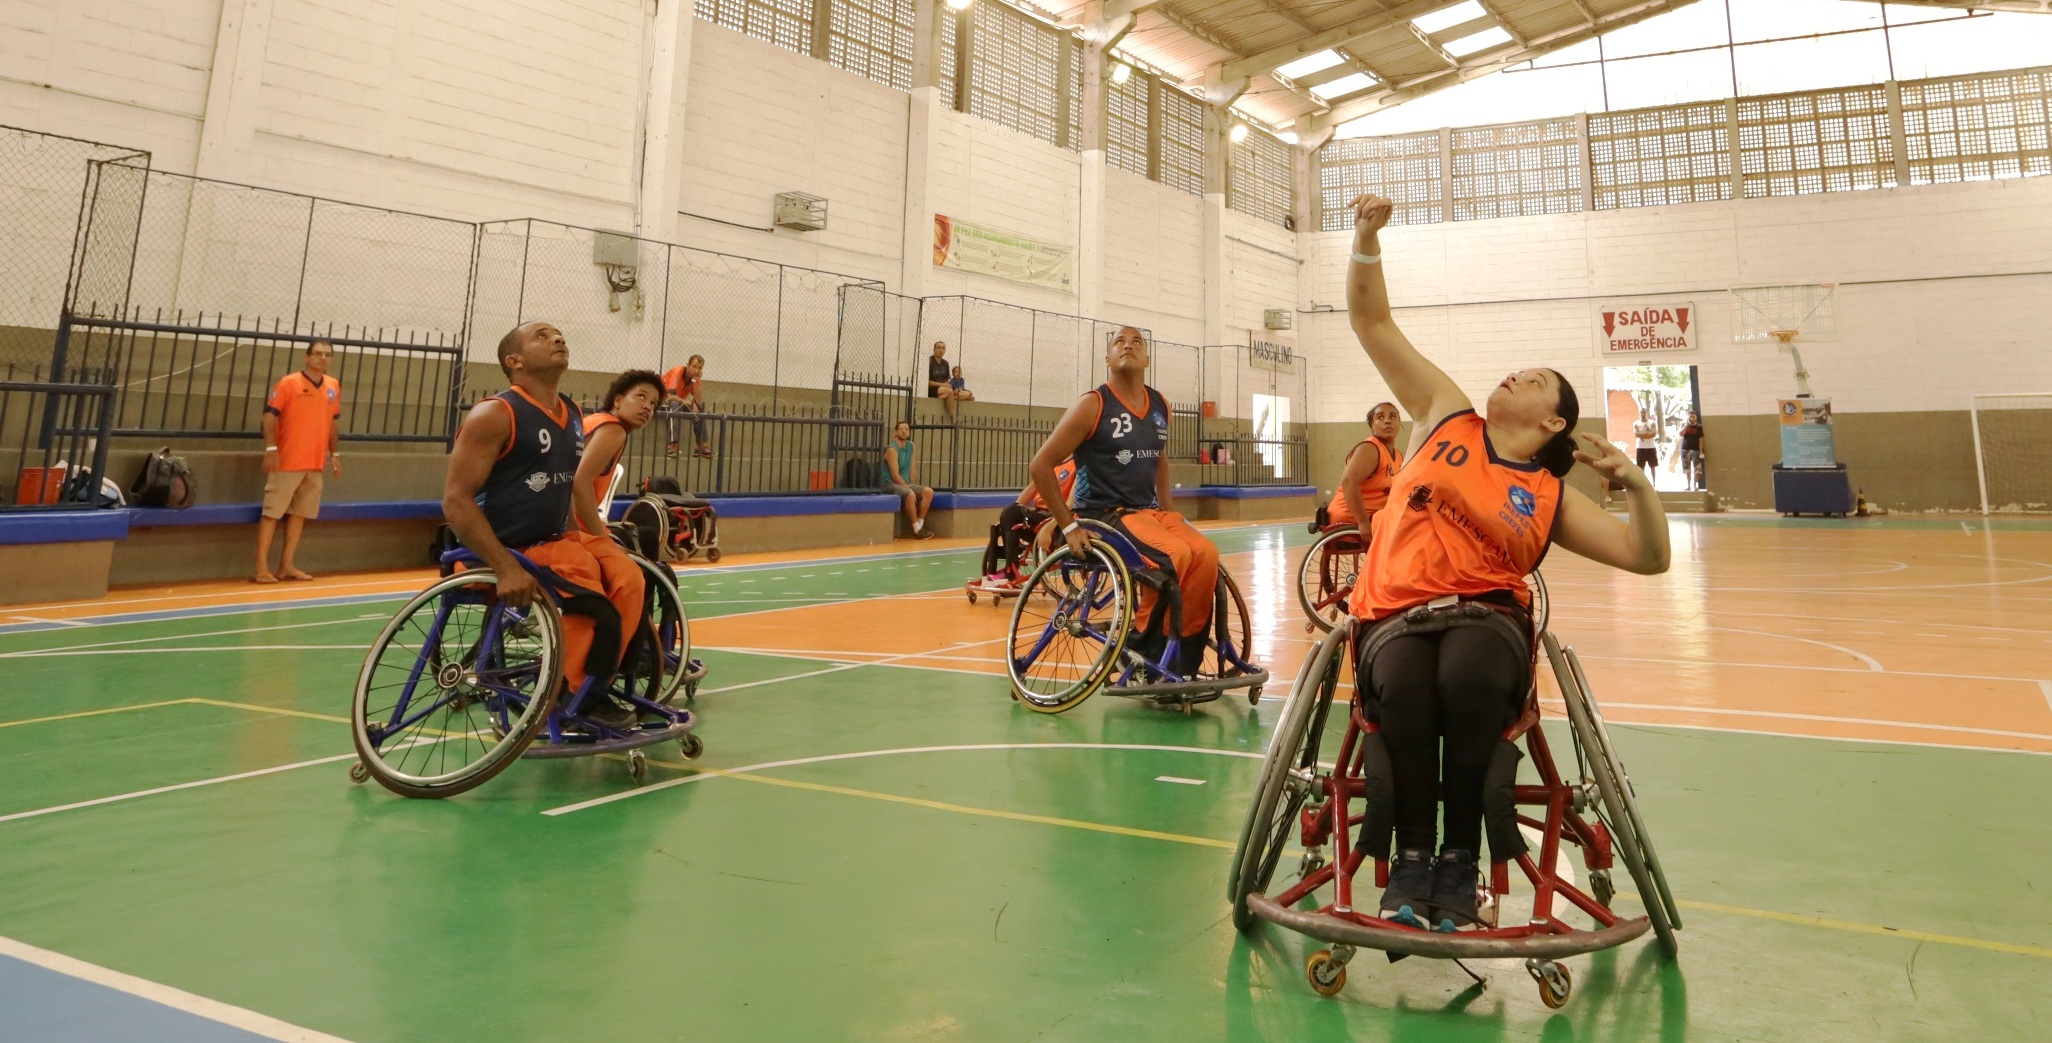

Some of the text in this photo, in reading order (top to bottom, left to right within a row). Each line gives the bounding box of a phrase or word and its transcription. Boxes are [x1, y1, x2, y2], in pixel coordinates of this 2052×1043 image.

[1618, 307, 1674, 326] SAÍDA
[1610, 336, 1687, 351] EMERGÊNCIA
[1640, 326, 1655, 338] DE
[1253, 339, 1292, 365] MASCULINO
[1110, 413, 1133, 439] 23
[538, 428, 551, 454] 9
[1431, 441, 1469, 467] 10
[1499, 510, 1524, 539] CREFES
